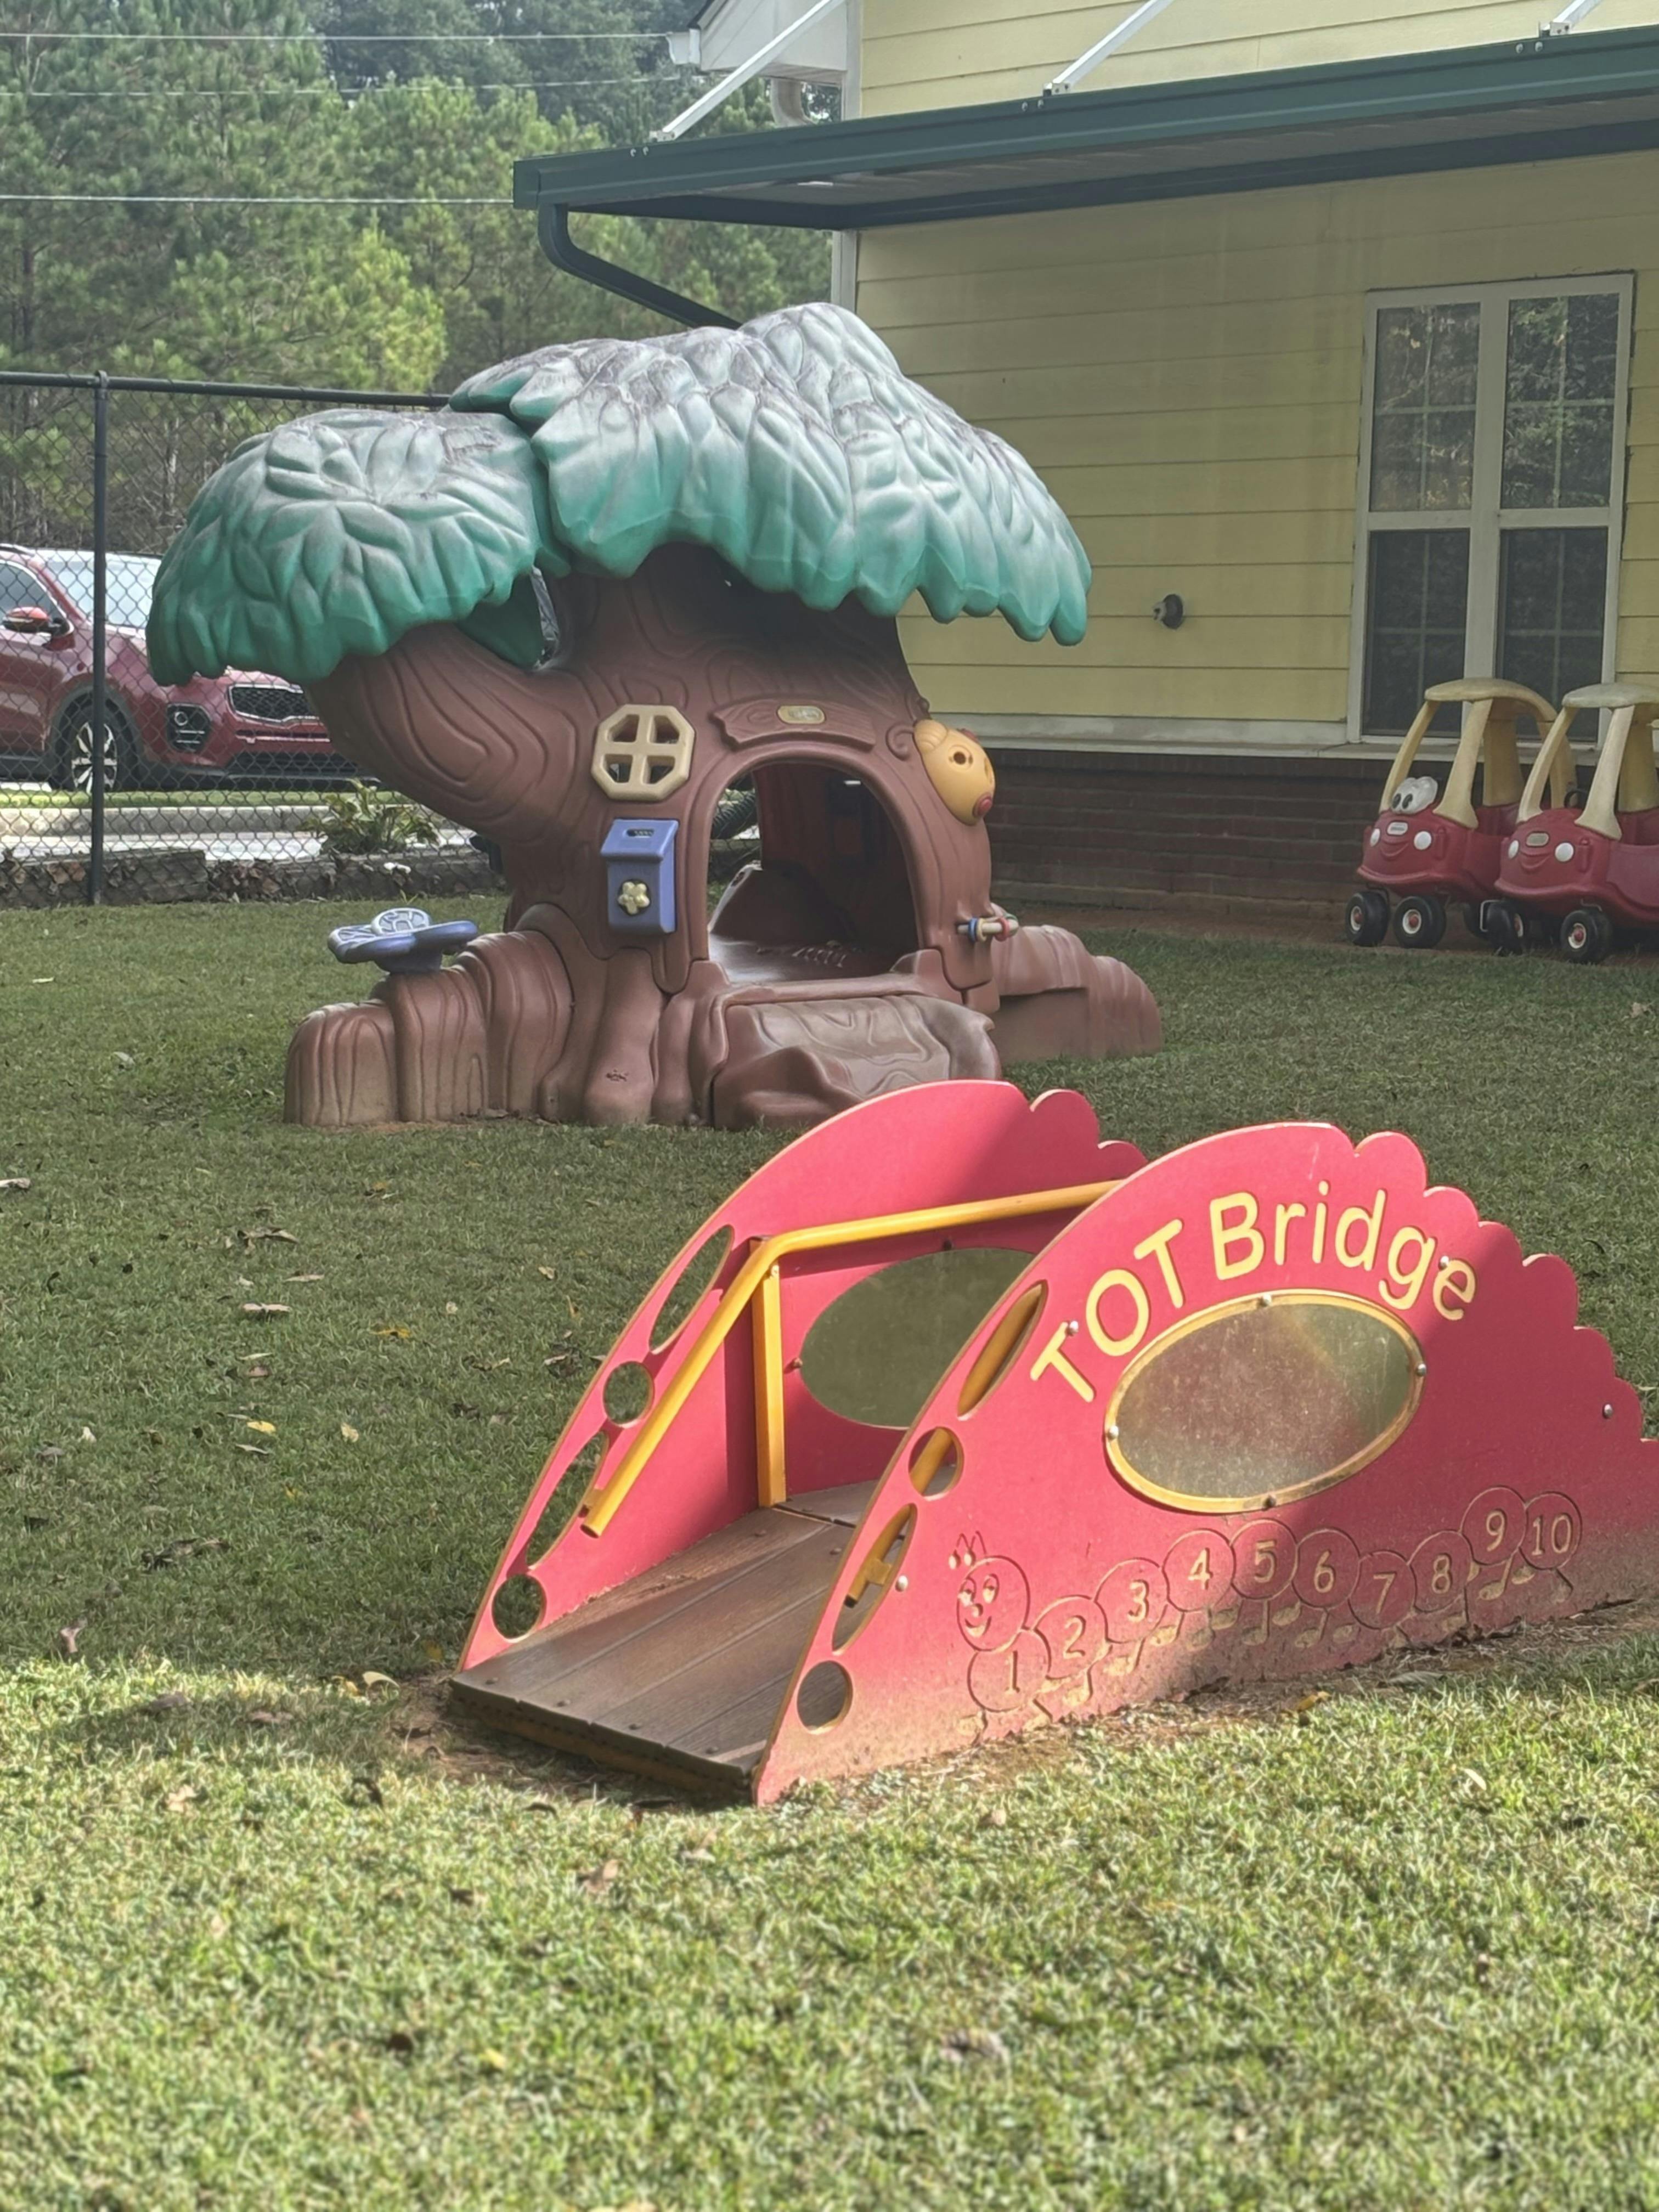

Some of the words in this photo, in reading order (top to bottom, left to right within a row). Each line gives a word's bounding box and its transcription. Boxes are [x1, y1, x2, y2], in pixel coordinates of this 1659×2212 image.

[1030, 1218, 1183, 1403] TOT
[1210, 1180, 1476, 1321] Bridge
[1005, 1650, 1020, 1693] 1
[1063, 1615, 1086, 1660] 2
[1127, 1579, 1149, 1623] 3
[1188, 1547, 1213, 1590] 4
[1254, 1540, 1277, 1583] 5
[1314, 1549, 1336, 1593] 6
[1373, 1572, 1397, 1615] 7
[1432, 1553, 1453, 1593] 8
[1486, 1508, 1508, 1552] 9
[1532, 1513, 1573, 1556] 10
